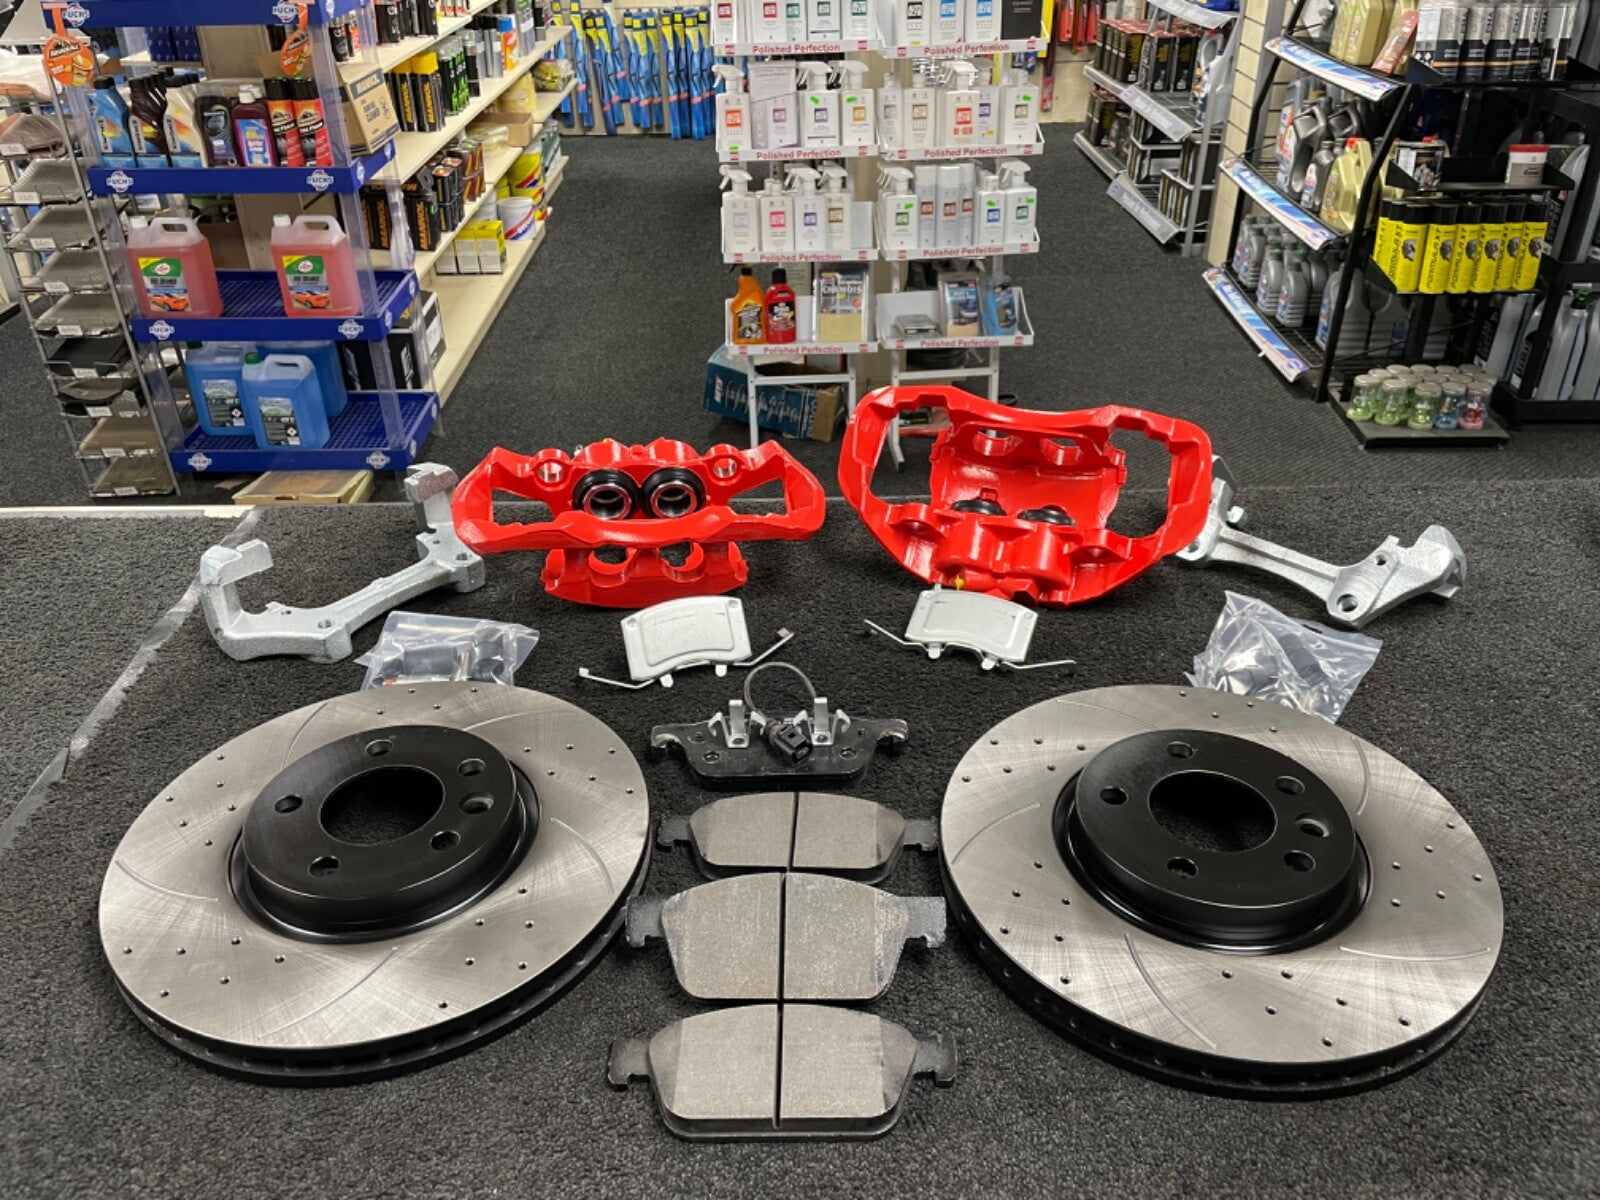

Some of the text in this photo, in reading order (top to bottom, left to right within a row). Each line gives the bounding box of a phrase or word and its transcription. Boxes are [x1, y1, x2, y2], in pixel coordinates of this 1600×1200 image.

[752, 44, 840, 54] Polished Perfection
[924, 44, 1010, 55] Polished Perfection
[757, 150, 841, 159] Polished Perfection
[924, 147, 1007, 157] Polished Perfection
[962, 246, 1004, 255] Perfection
